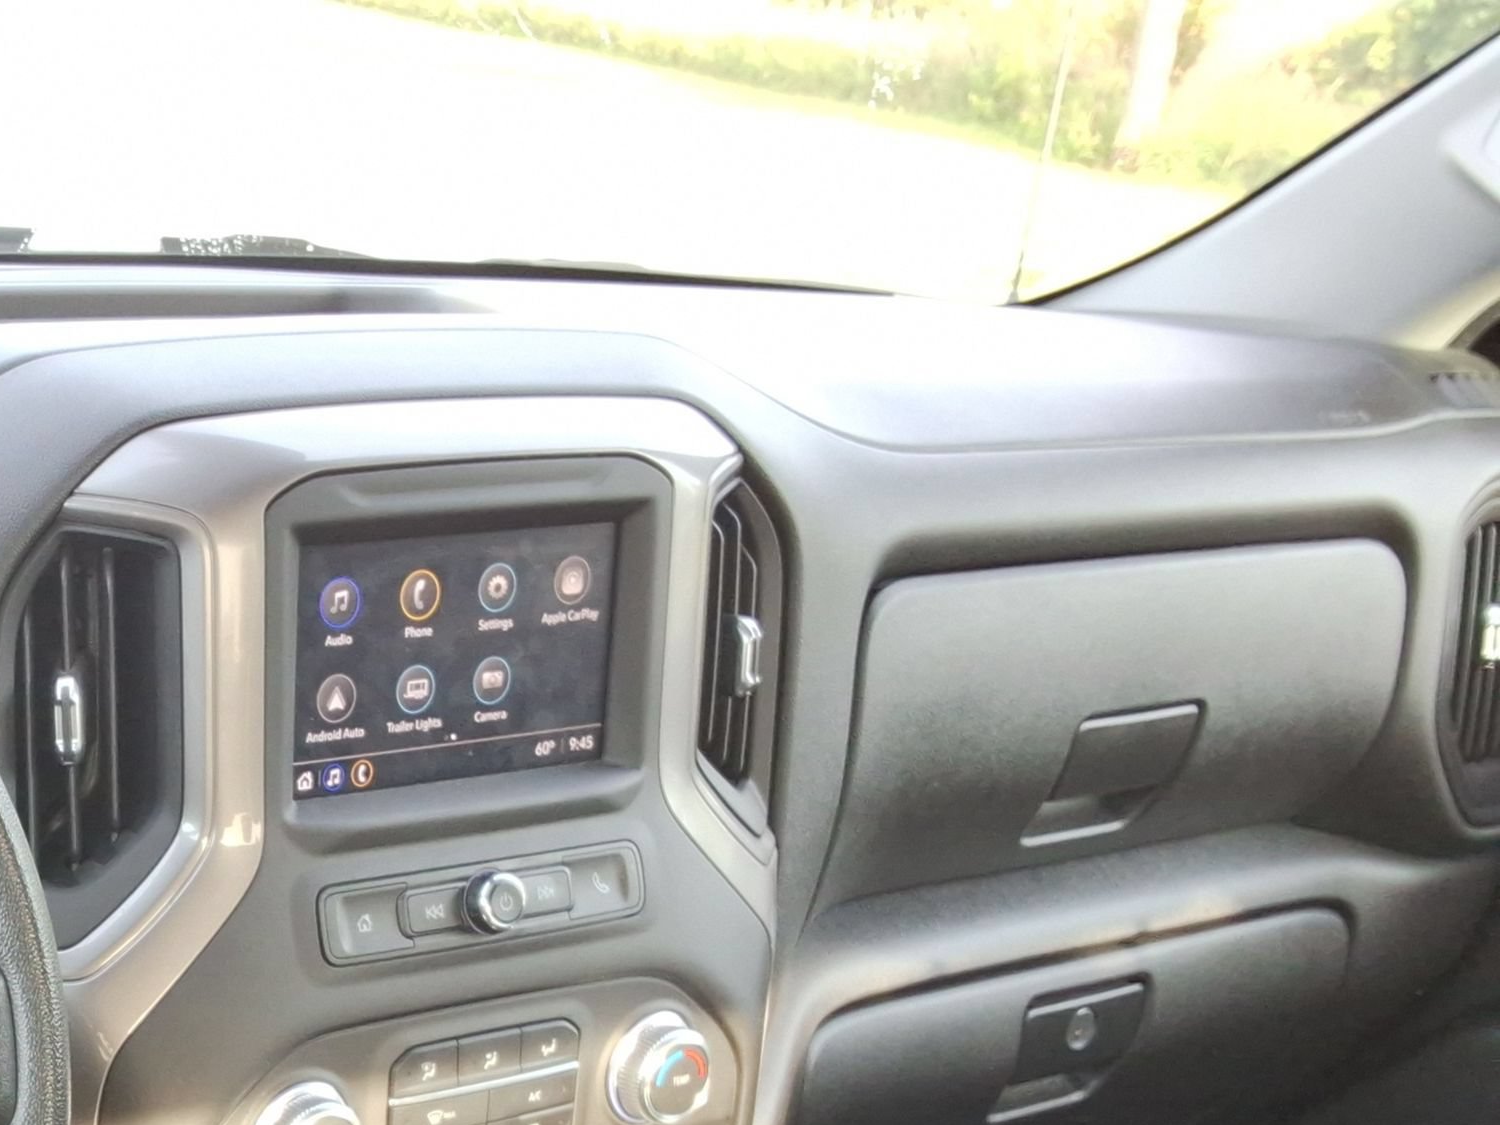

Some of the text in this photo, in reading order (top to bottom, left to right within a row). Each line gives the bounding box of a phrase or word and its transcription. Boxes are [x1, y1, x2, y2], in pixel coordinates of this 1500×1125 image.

[477, 617, 514, 632] Settings
[541, 608, 599, 626] Apple CarPlay
[404, 624, 434, 638] Phone
[324, 633, 353, 647] Audio
[386, 716, 442, 734] Trailer Lights
[305, 726, 365, 744] Android Auto
[568, 735, 594, 751] 9:45
